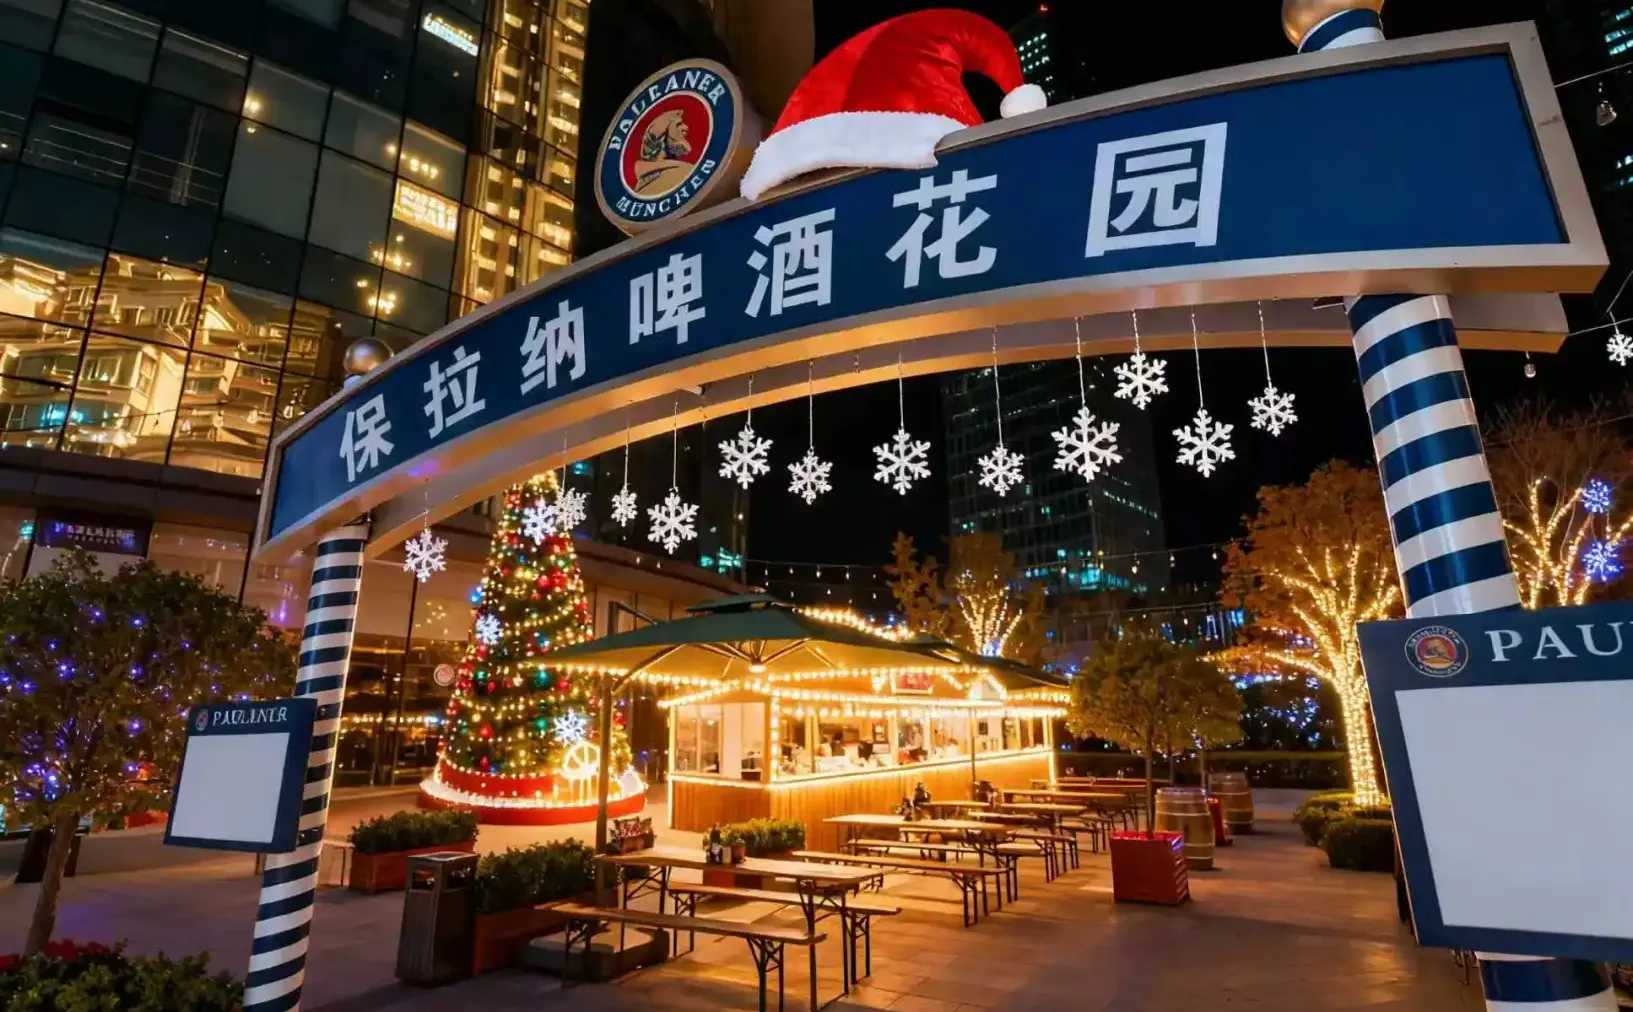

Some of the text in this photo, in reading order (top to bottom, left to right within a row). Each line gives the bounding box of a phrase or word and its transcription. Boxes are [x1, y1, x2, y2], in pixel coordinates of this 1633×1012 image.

[338, 121, 1228, 483] 保拉纳啤酒花园
[1484, 621, 1633, 662] PAU
